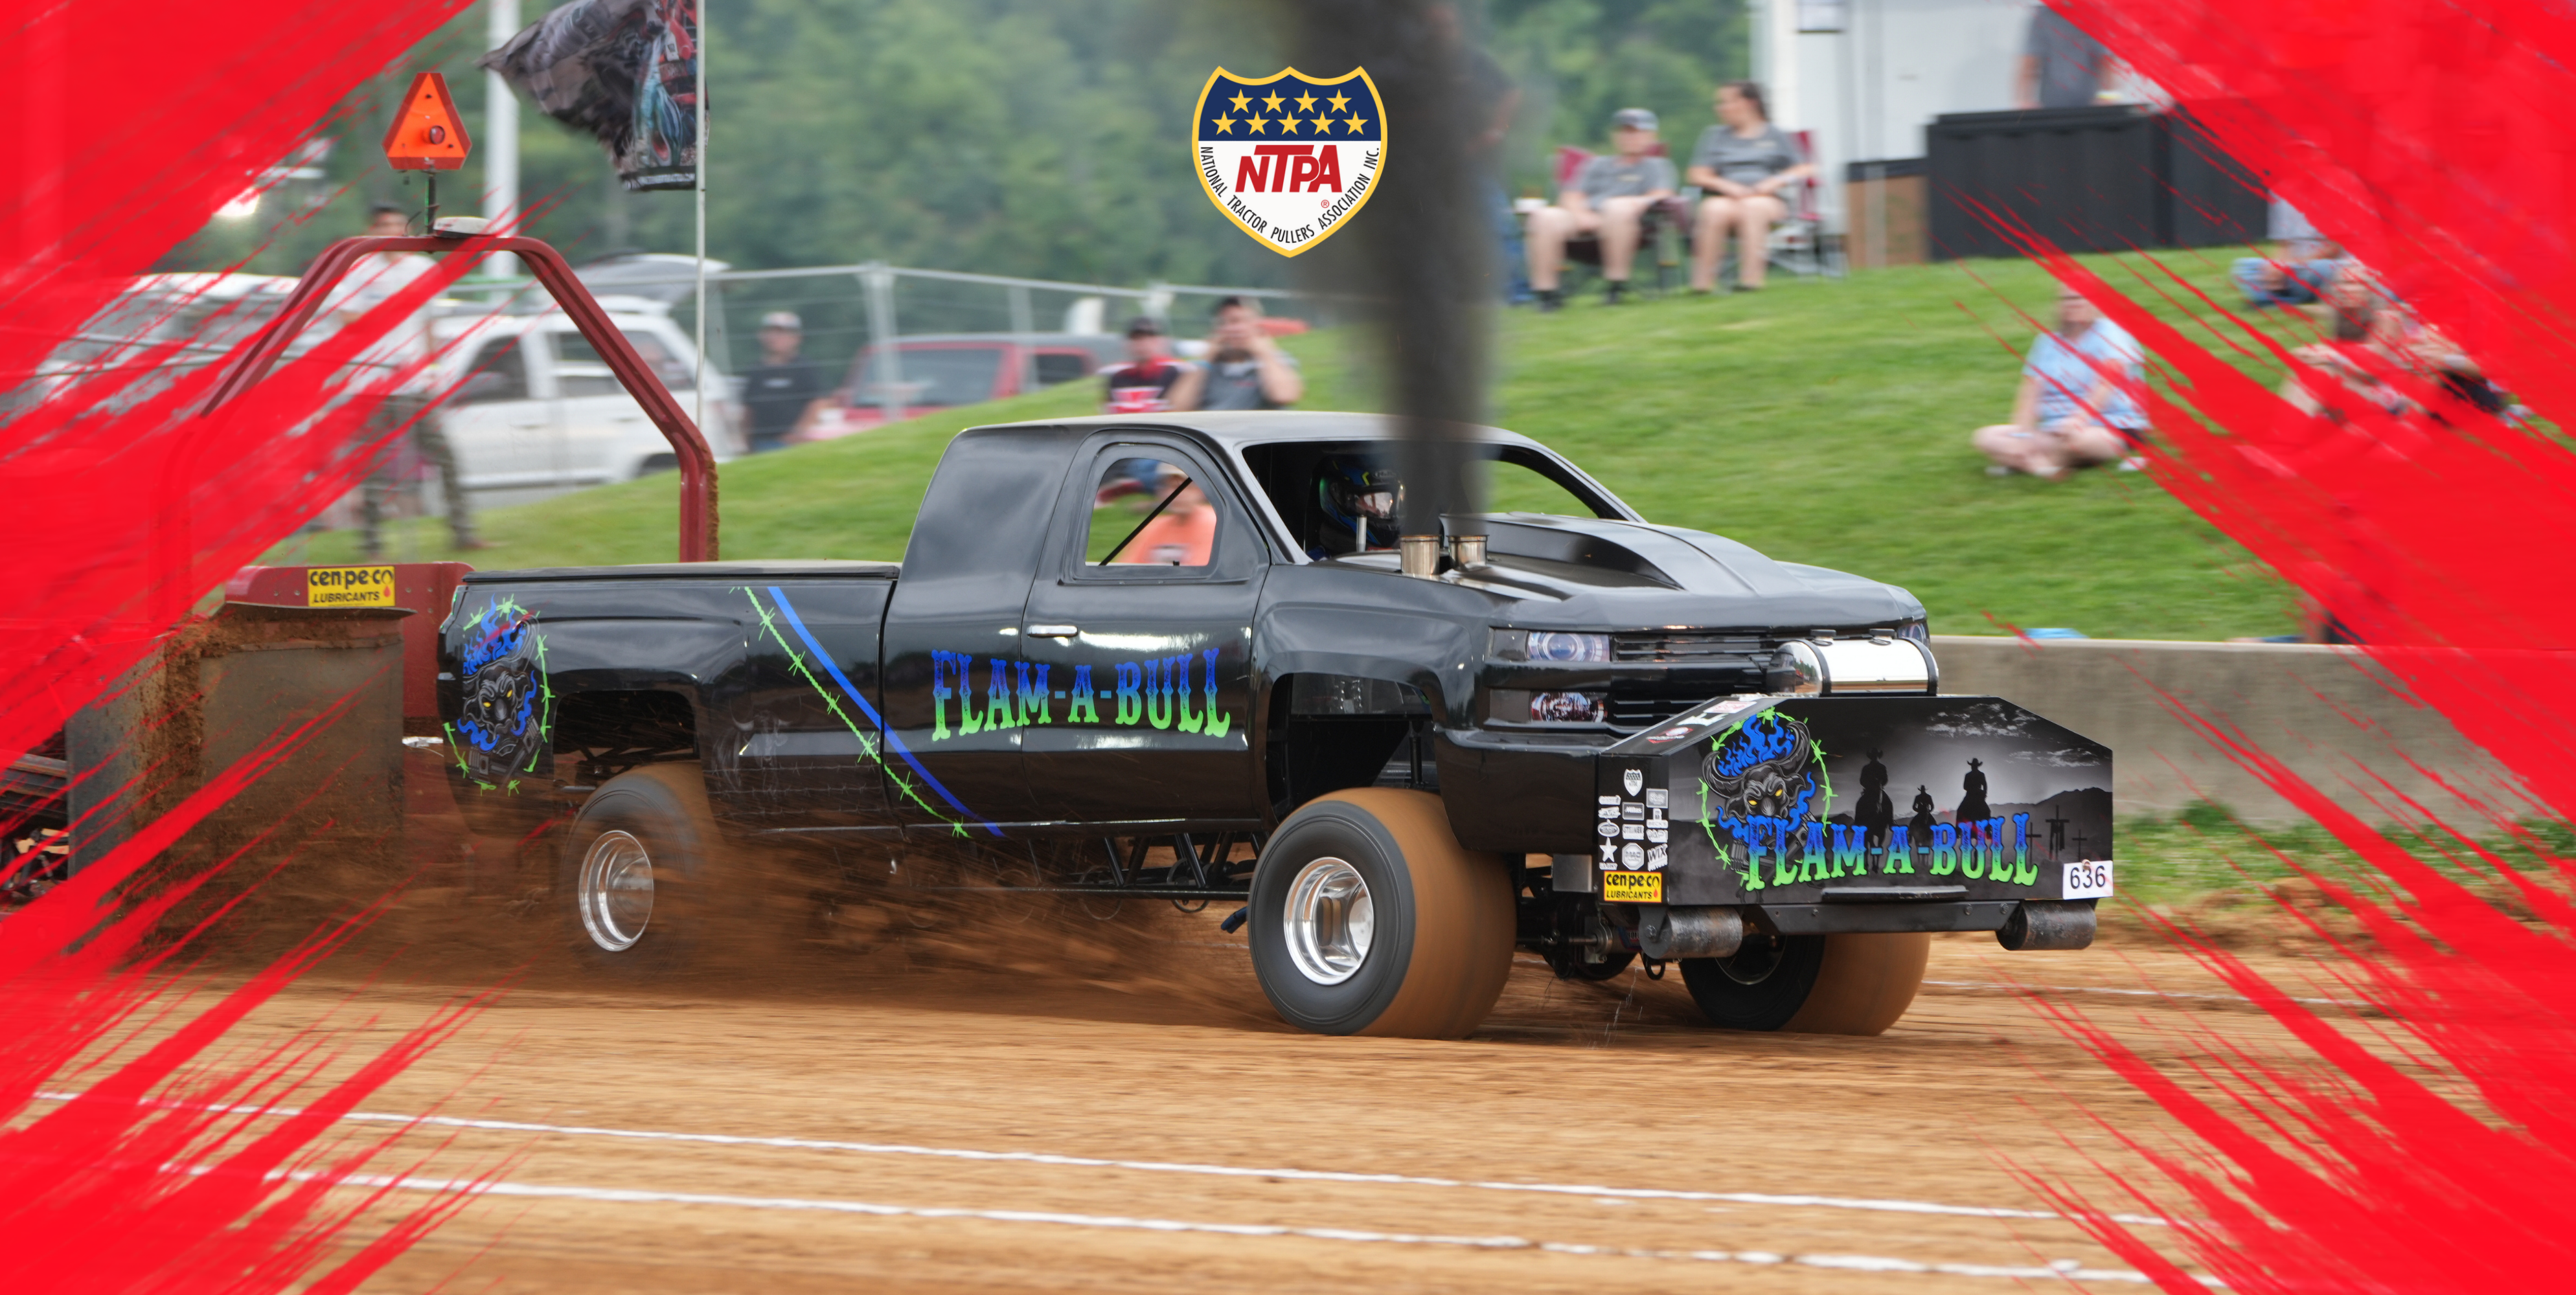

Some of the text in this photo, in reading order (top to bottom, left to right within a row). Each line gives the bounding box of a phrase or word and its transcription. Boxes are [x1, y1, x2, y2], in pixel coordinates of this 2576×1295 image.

[313, 591, 380, 603] LUBRICANTS
[931, 648, 1231, 741] FLAM-A-BULL
[1648, 844, 1667, 862] WIX
[1745, 813, 2038, 892] FLAM-A-BULL
[2070, 865, 2106, 889] 636
[1606, 890, 1652, 899] LUBRICANTS
